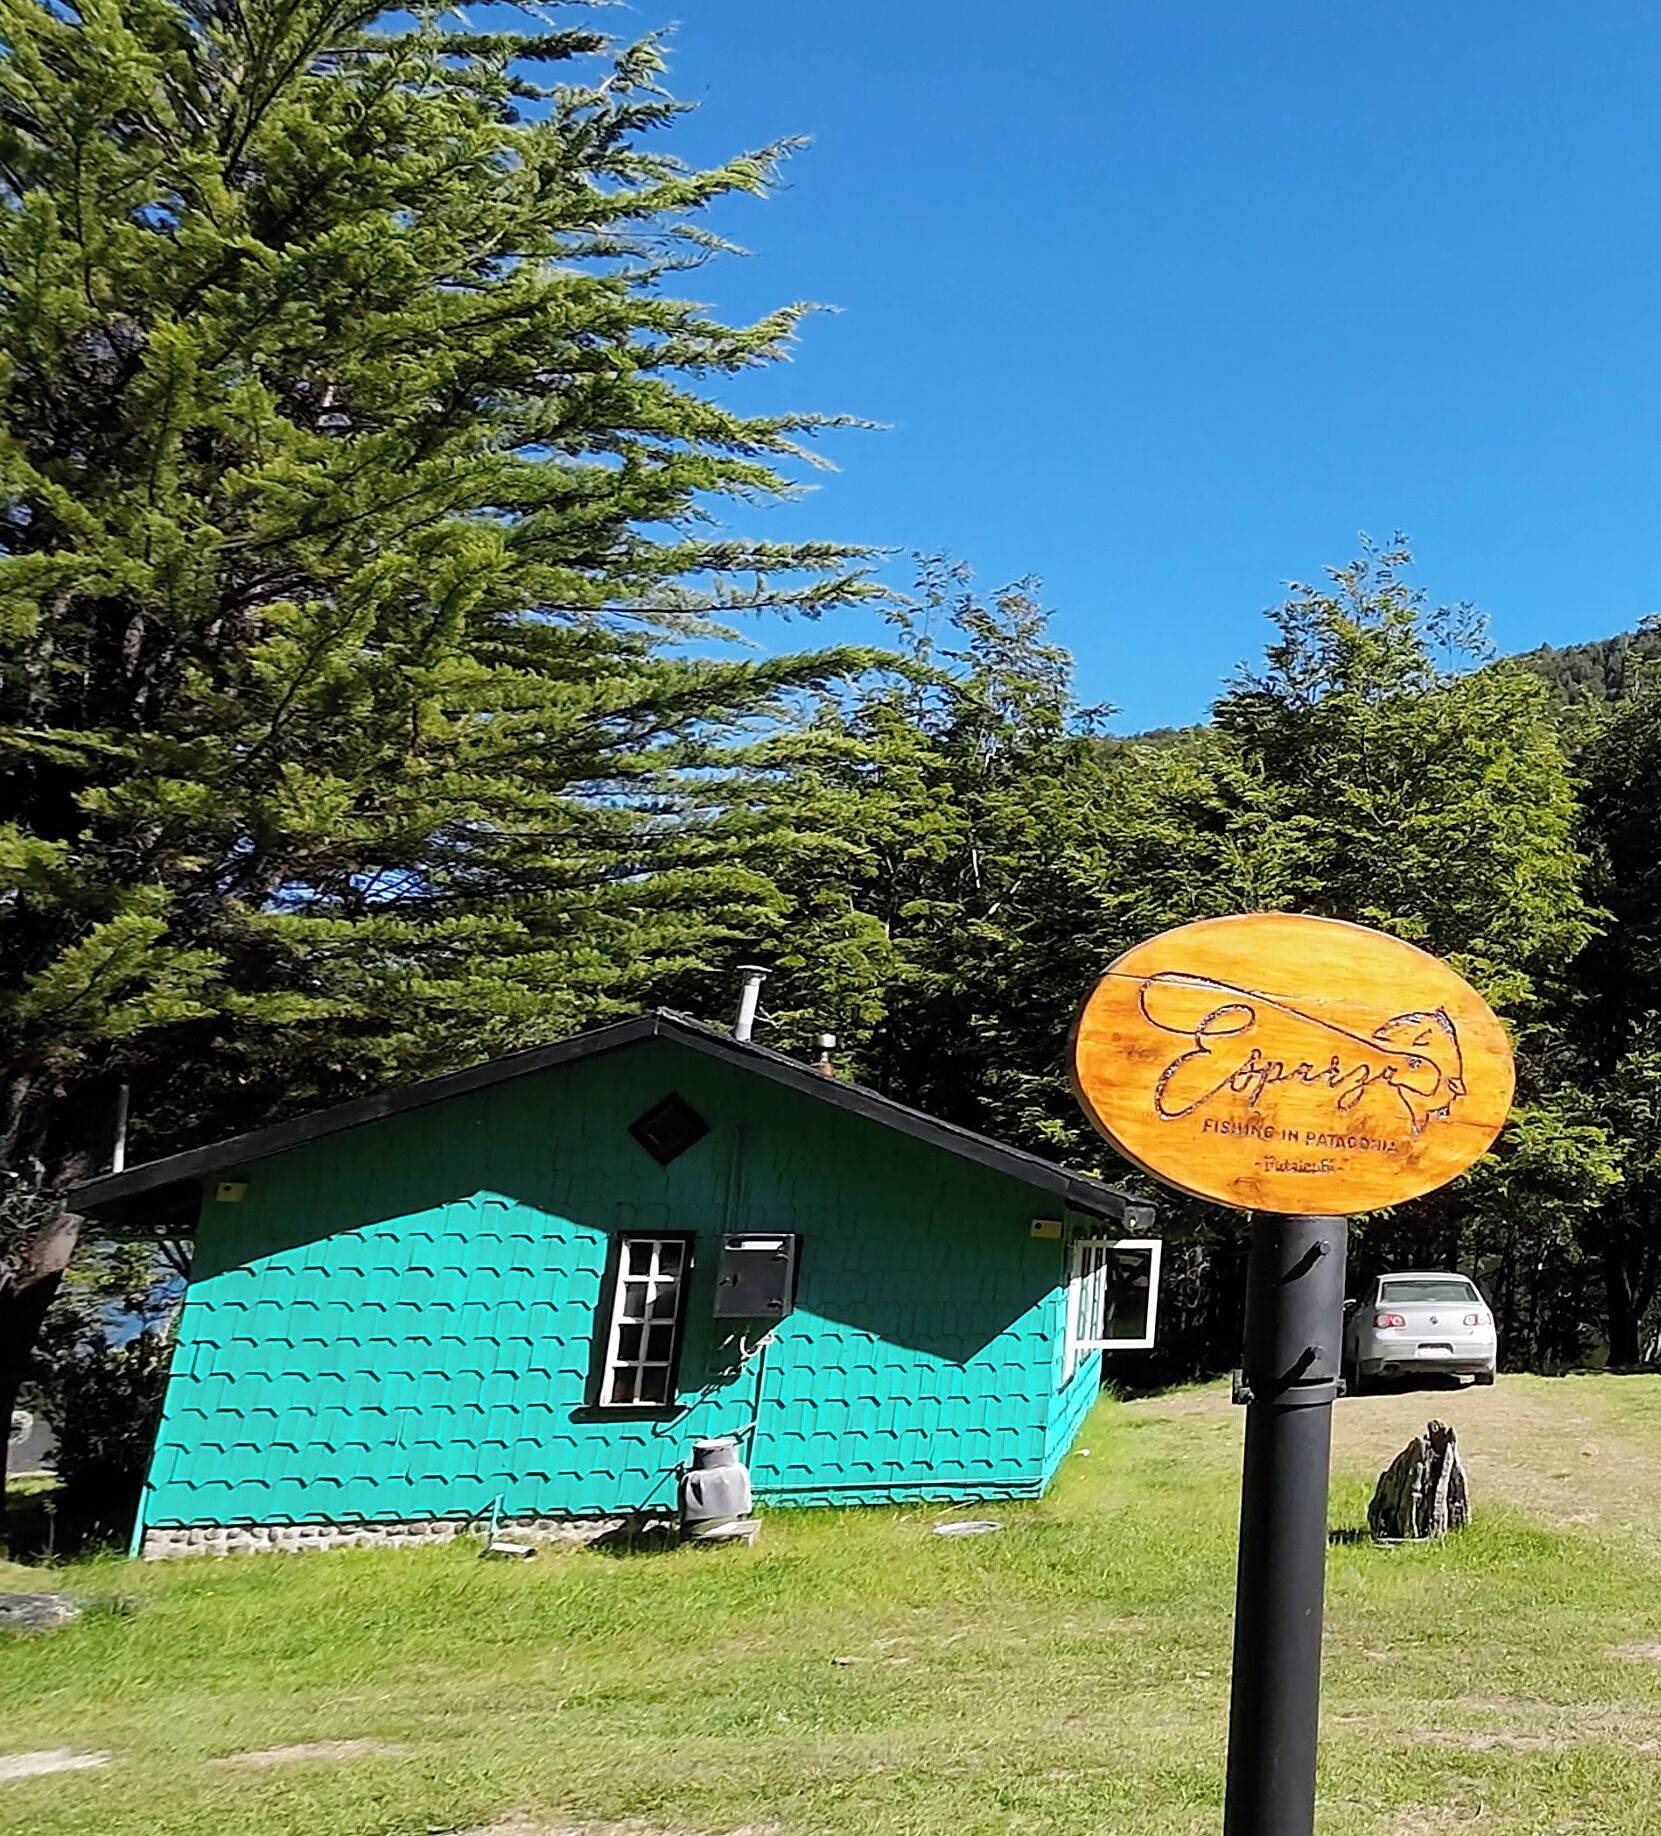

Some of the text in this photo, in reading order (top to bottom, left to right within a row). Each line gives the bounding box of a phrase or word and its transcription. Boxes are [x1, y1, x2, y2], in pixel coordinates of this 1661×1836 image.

[1203, 1117, 1399, 1152] FISHING IN PATAGONIA
